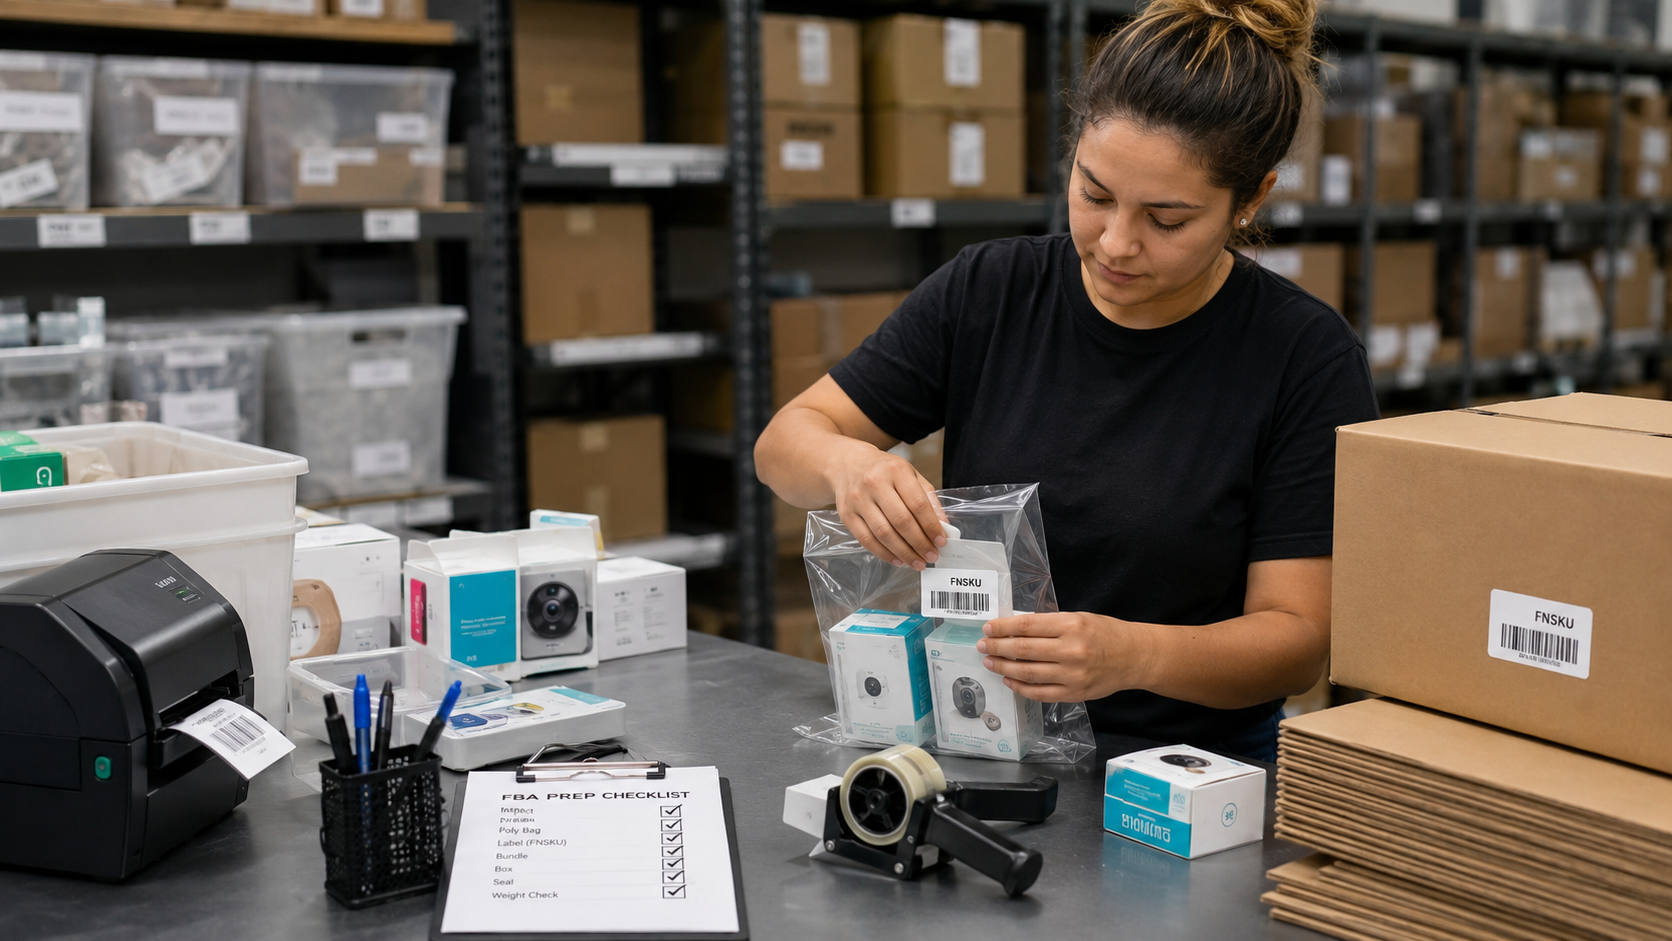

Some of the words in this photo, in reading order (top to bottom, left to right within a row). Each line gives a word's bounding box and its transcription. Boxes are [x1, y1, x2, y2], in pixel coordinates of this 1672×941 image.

[950, 577, 982, 588] FNSKU
[1535, 611, 1574, 629] FNSKU
[499, 827, 519, 835] Poly
[523, 827, 541, 835] Bag
[526, 838, 567, 846] (FNSKU)
[492, 892, 525, 900] Weight
[529, 891, 558, 899] Check
